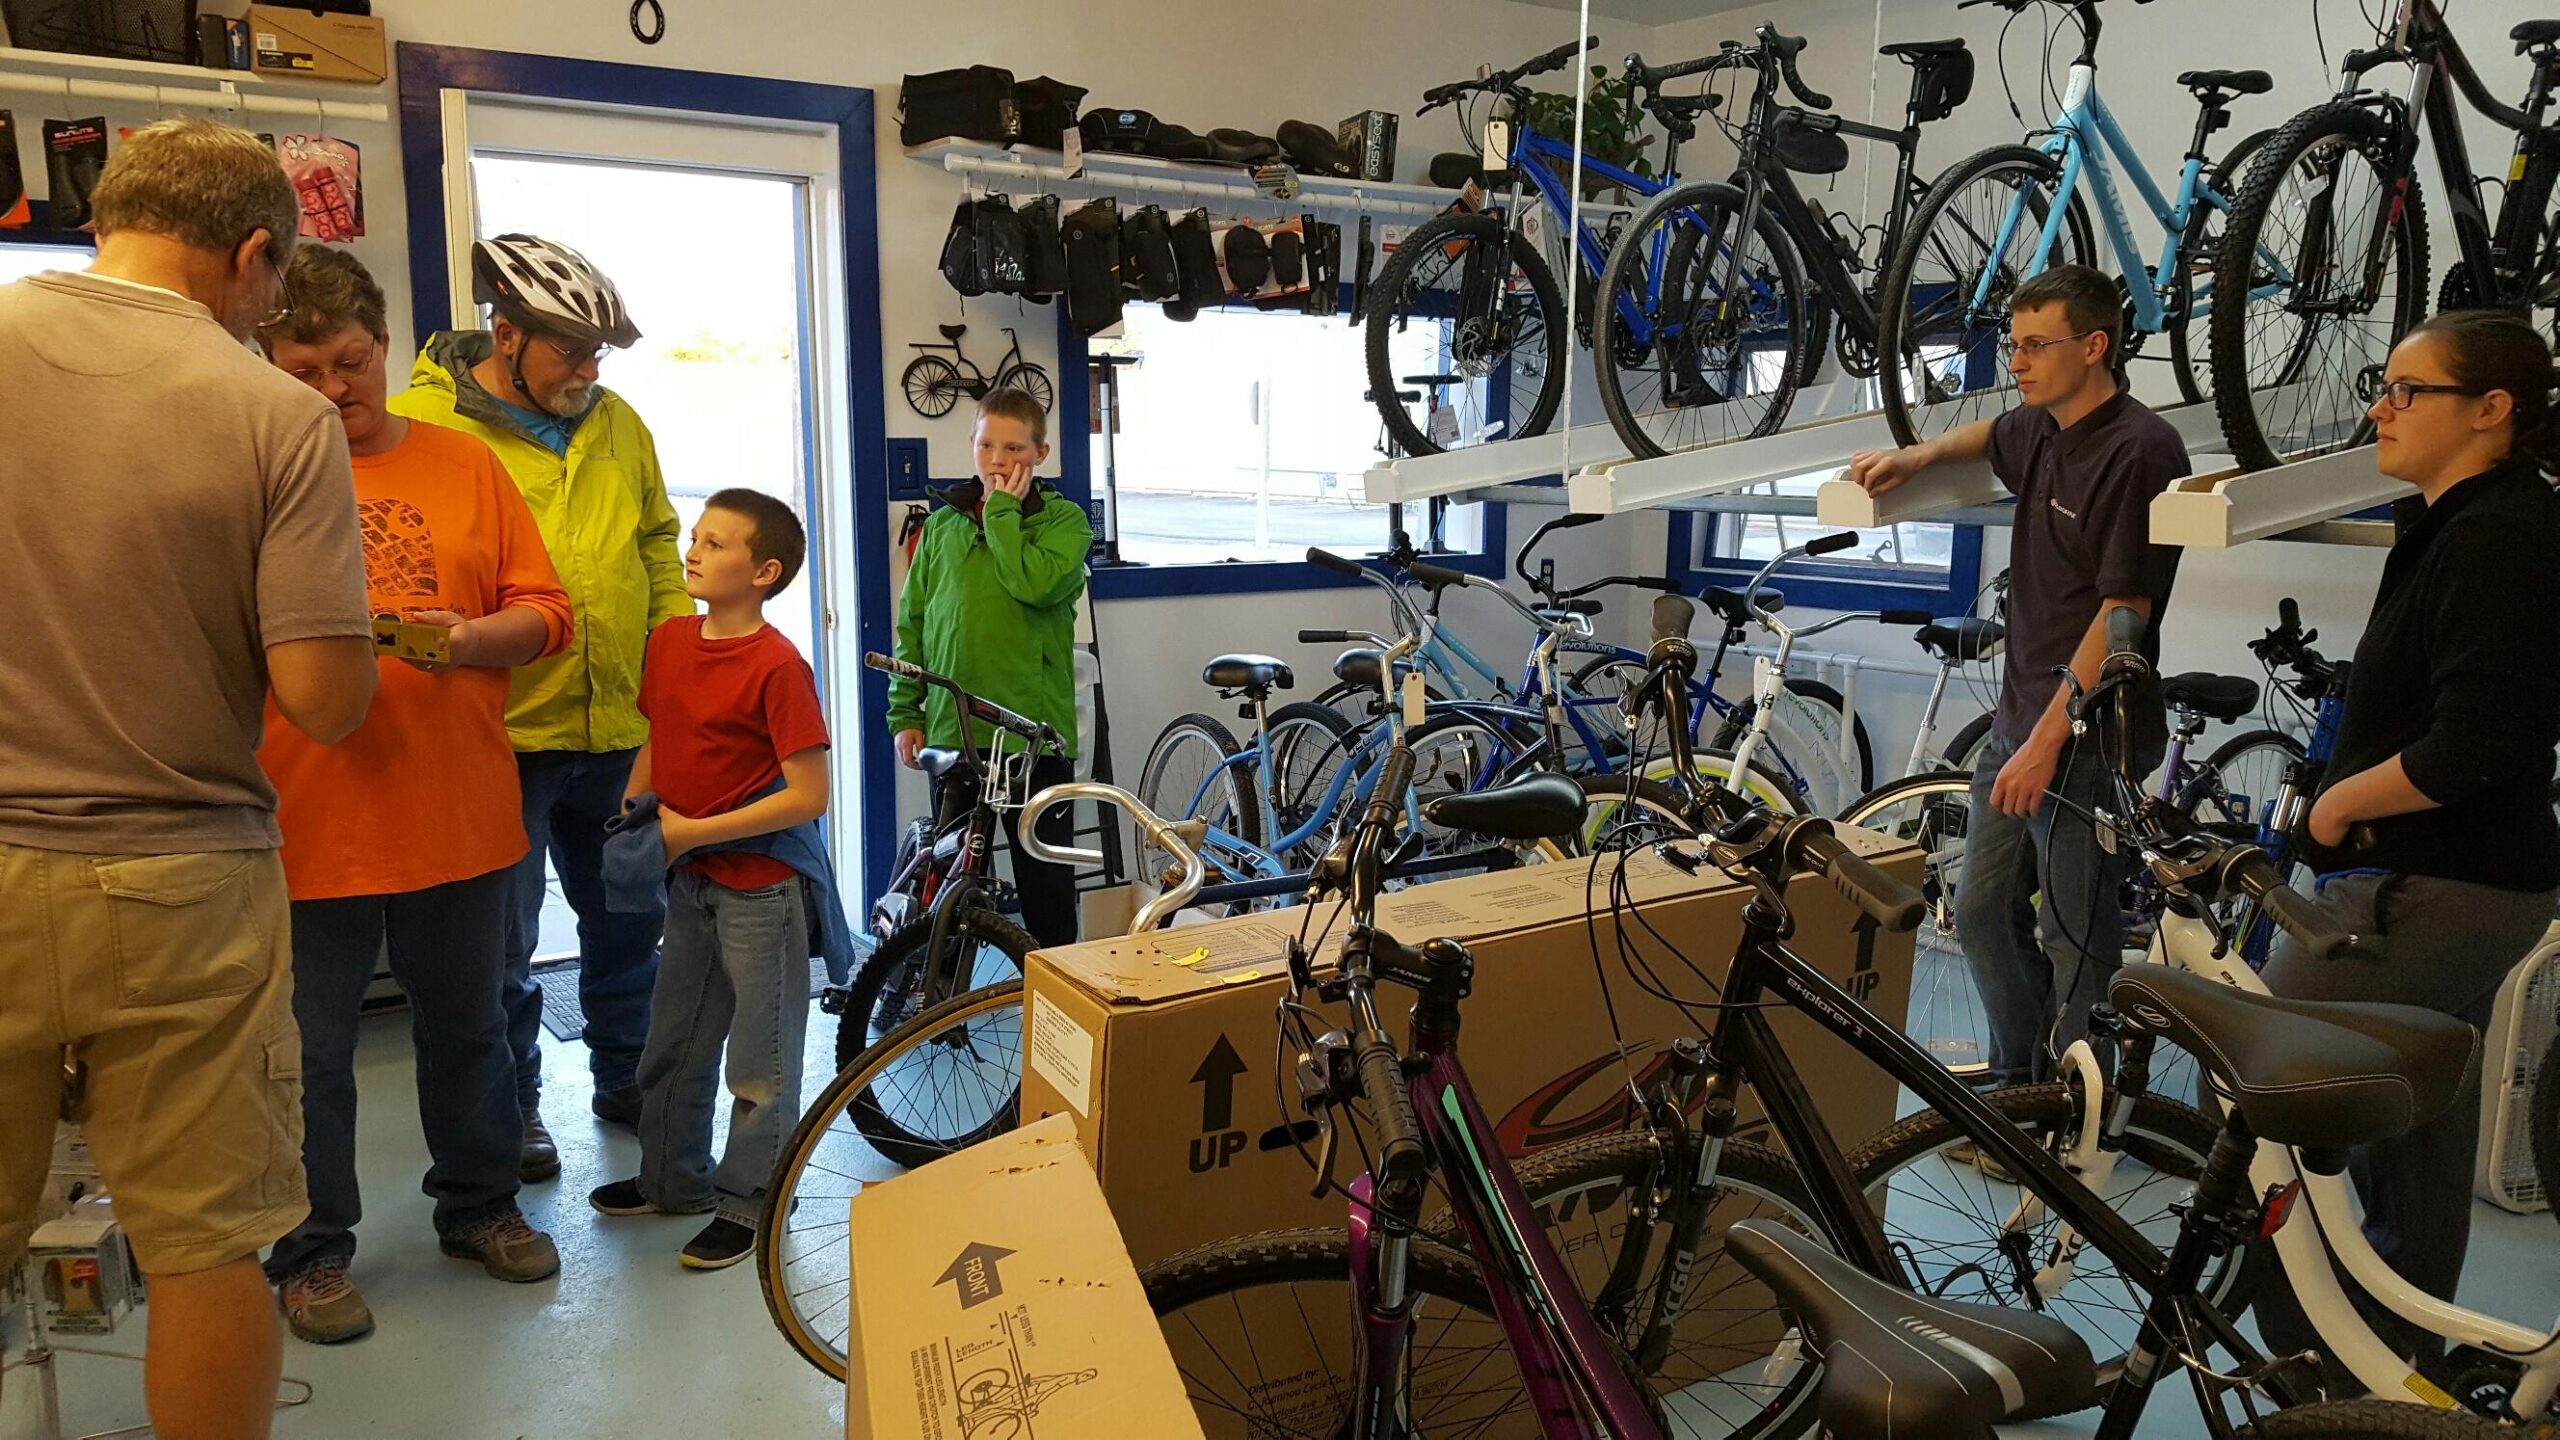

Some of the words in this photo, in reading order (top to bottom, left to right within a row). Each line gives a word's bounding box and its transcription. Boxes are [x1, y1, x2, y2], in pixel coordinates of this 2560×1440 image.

[1369, 111, 1383, 177] easyseat
[1786, 977, 1852, 1027] explorer
[1189, 1130, 1248, 1173] UP
[964, 1256, 990, 1298] FRONT
[1020, 1316, 1031, 1329] LESS
[1023, 1327, 1033, 1343] THAN
[955, 1342, 974, 1353] LEG
[956, 1339, 993, 1358] LENGTH
[1248, 1371, 1304, 1395] Distributed
